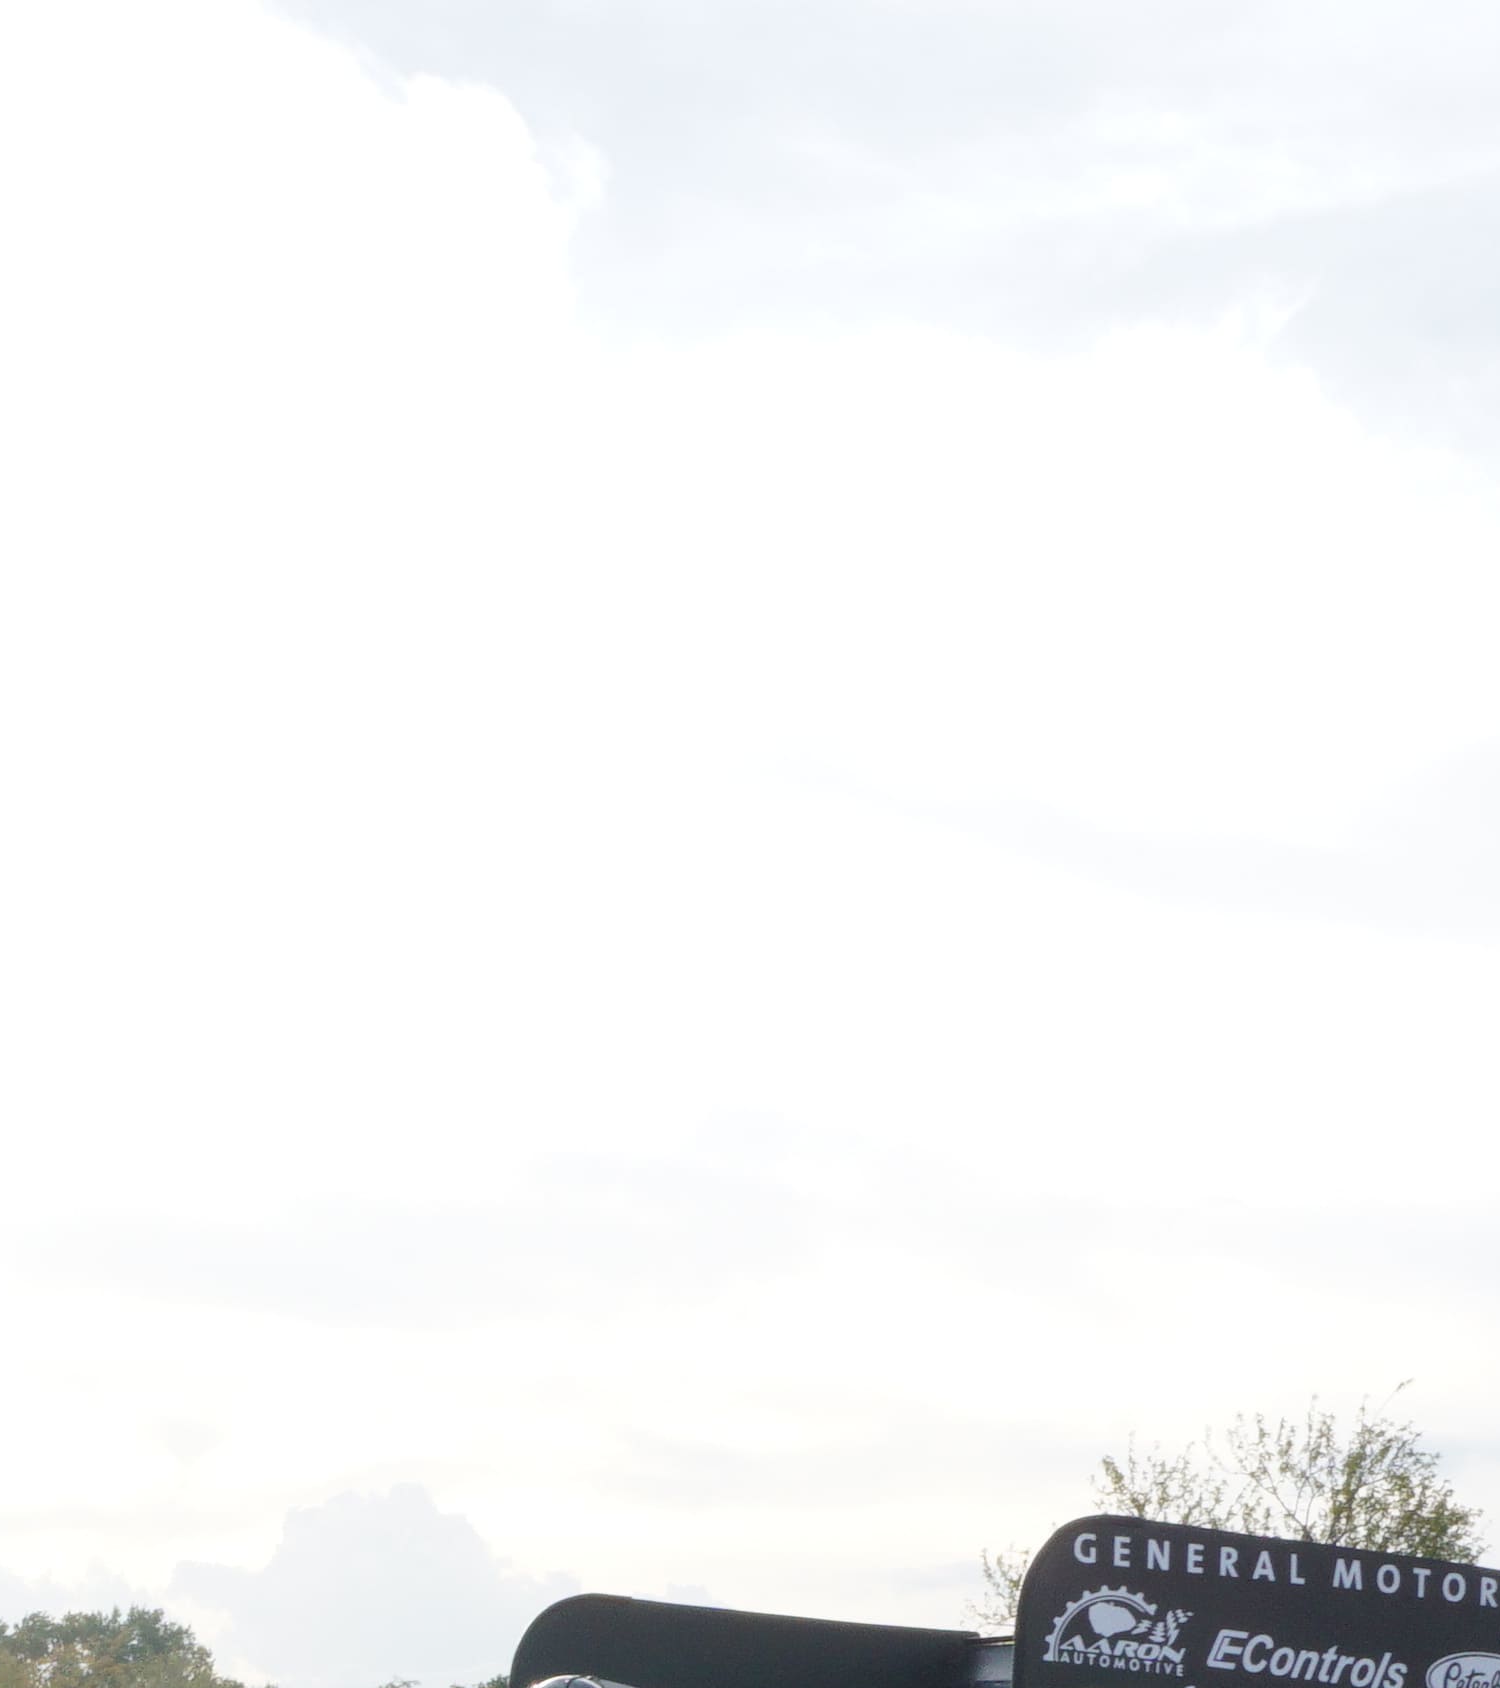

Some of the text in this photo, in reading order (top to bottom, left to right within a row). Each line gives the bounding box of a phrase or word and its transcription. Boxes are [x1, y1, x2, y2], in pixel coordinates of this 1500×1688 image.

[1074, 1532, 1306, 1586] GENERAL
[1060, 1635, 1187, 1664] AARON
[1060, 1652, 1184, 1677] AUTOMOTIVE
